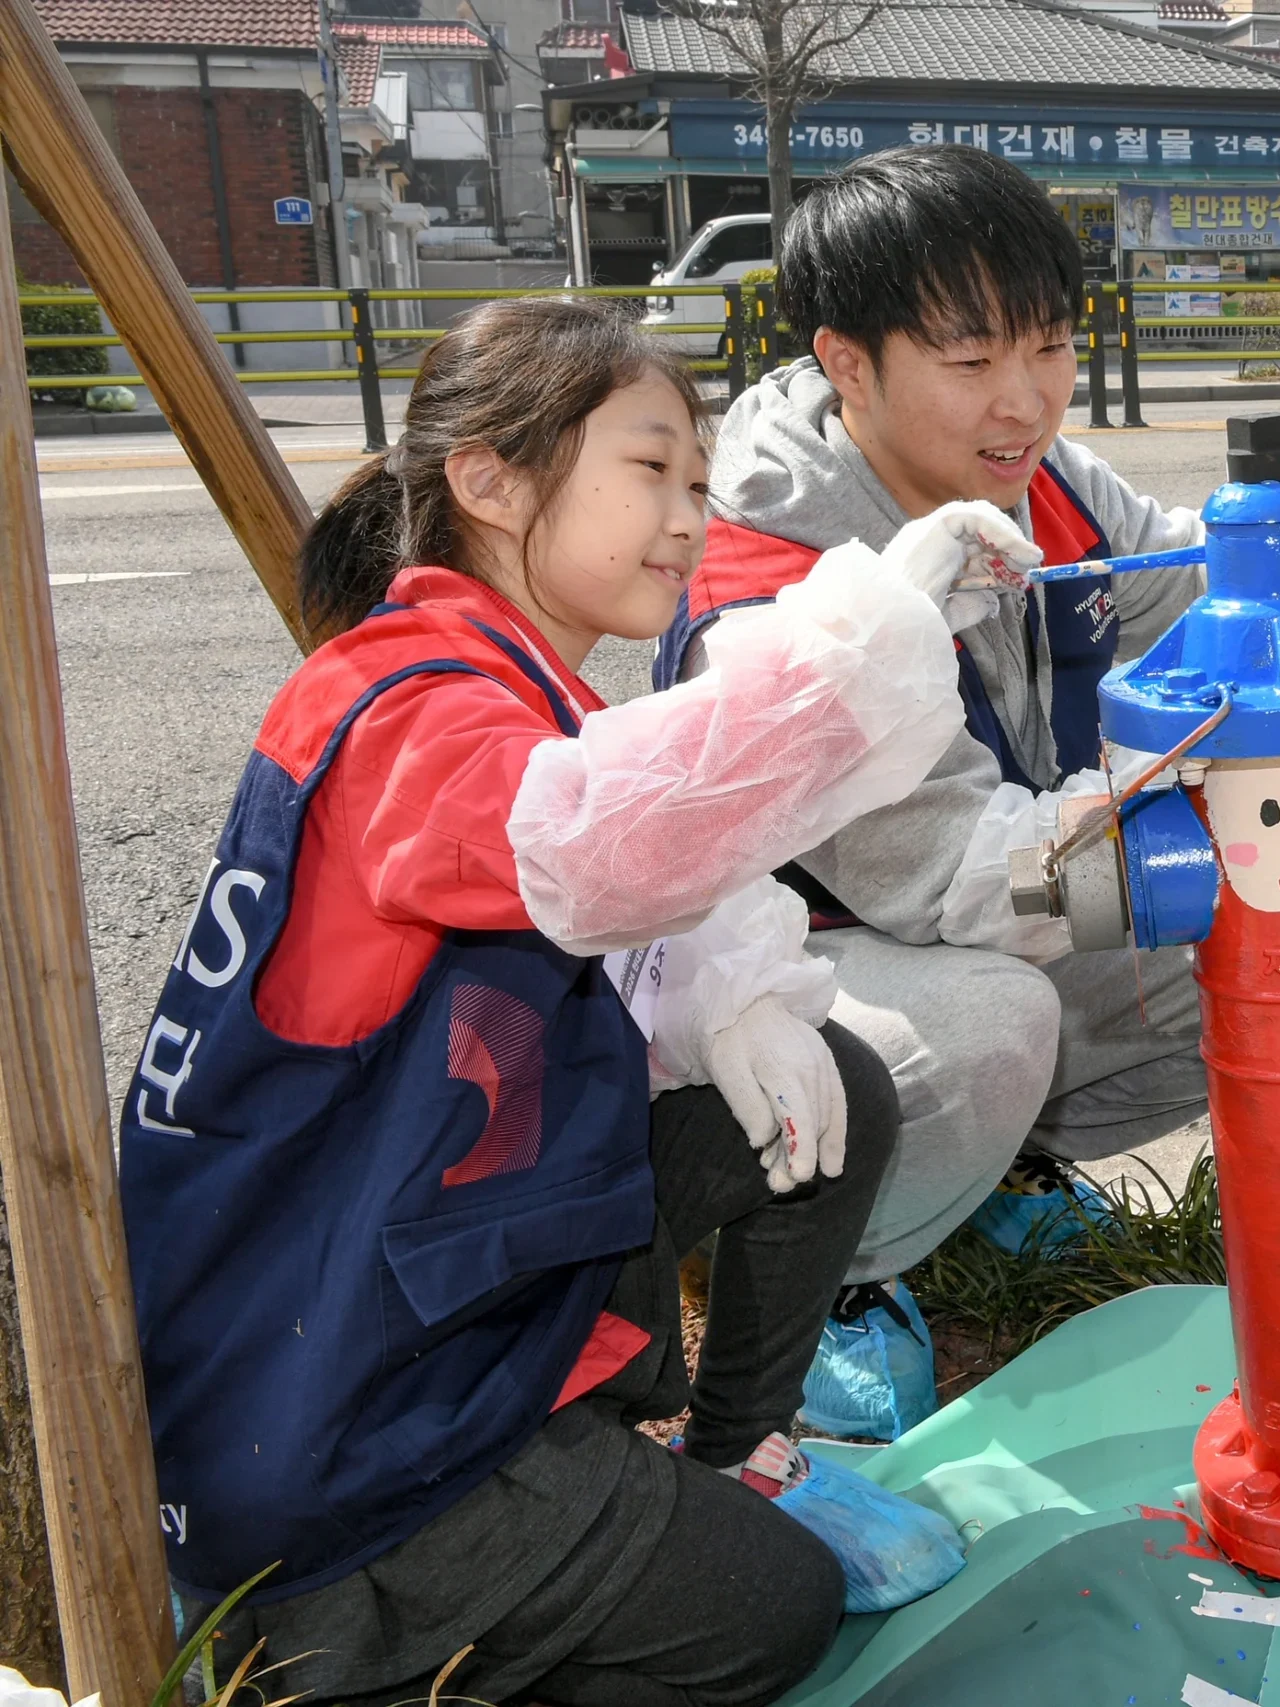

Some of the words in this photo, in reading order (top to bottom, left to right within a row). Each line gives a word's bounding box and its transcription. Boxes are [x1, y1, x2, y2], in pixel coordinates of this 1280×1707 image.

[733, 123, 864, 148] 34-7650
[1115, 126, 1194, 160] 철물
[285, 202, 300, 212] 111
[1203, 233, 1274, 246] 현대종합건재
